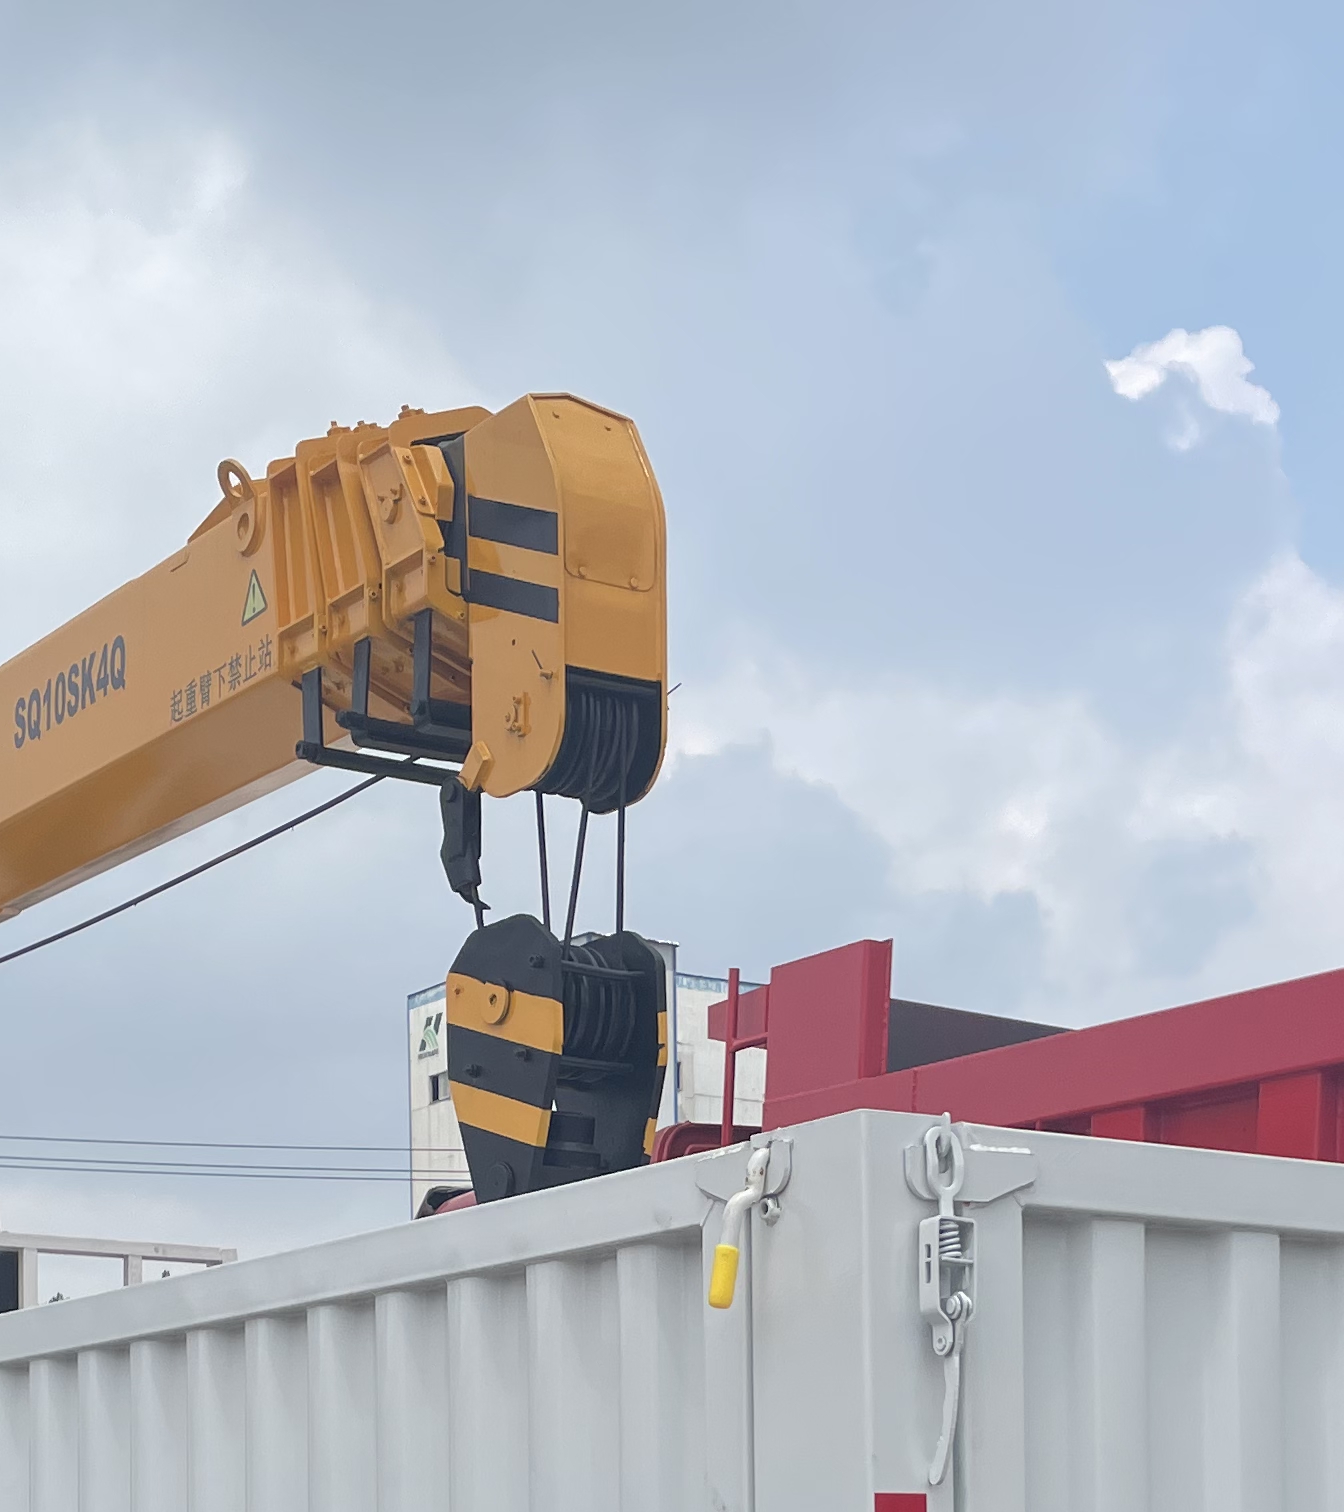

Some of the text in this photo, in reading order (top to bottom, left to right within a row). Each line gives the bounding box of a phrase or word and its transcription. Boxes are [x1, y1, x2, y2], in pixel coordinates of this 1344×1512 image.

[13, 634, 126, 749] SQ10SK4Q
[169, 633, 273, 725] 起重臂下禁止站
